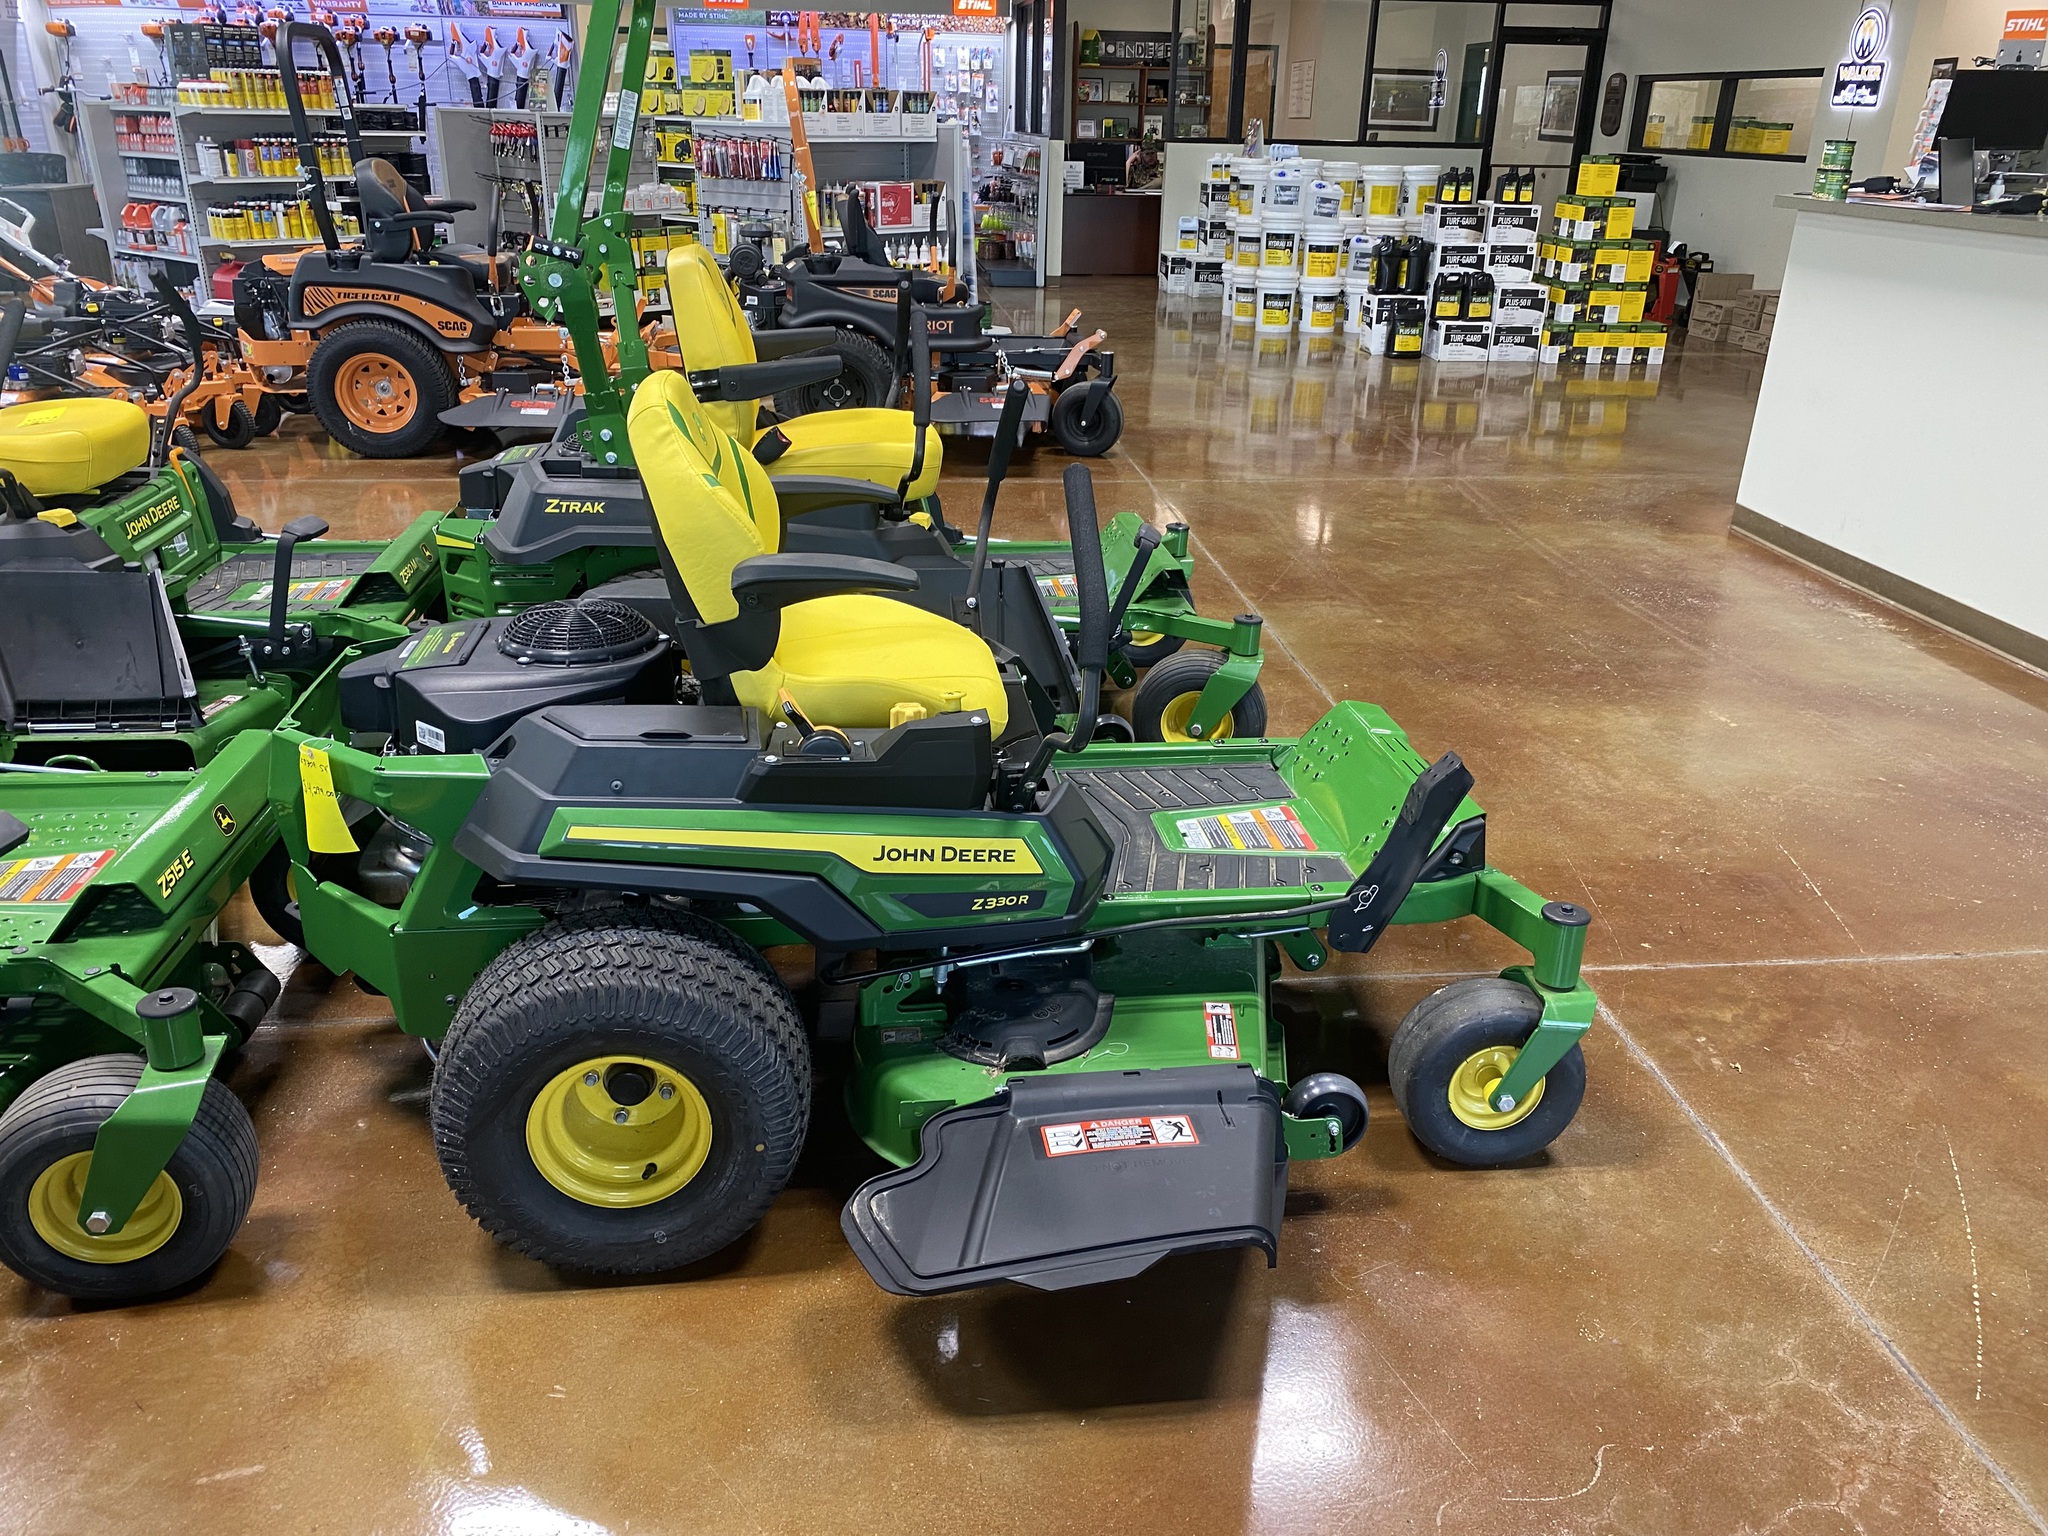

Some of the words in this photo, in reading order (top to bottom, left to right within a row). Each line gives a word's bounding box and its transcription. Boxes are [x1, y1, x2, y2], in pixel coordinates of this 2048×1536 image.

[312, 0, 361, 8] WARRANTY
[958, 0, 993, 9] STIHL
[2004, 18, 2046, 32] STIHL
[1839, 65, 1882, 82] WALKER
[1446, 217, 1477, 225] TURF-GARD
[1497, 217, 1520, 225] PLUS-50
[1446, 255, 1477, 264] TURF-GARD
[1494, 254, 1519, 263] PLUS-50
[335, 291, 370, 300] TIGER
[371, 293, 392, 301] CAT
[872, 289, 897, 298] SCAG
[1505, 298, 1526, 306] PLUS-50
[438, 320, 467, 332] SCAG
[1450, 334, 1482, 342] TURF-GARD
[1499, 335, 1520, 343] PLUS-50
[544, 499, 606, 514] ZTRAK
[125, 513, 152, 540] JOHN
[148, 495, 180, 524] DEERE
[872, 845, 935, 862] JOHN
[941, 846, 1016, 863] DEERE
[1100, 1118, 1143, 1128] DANGER
